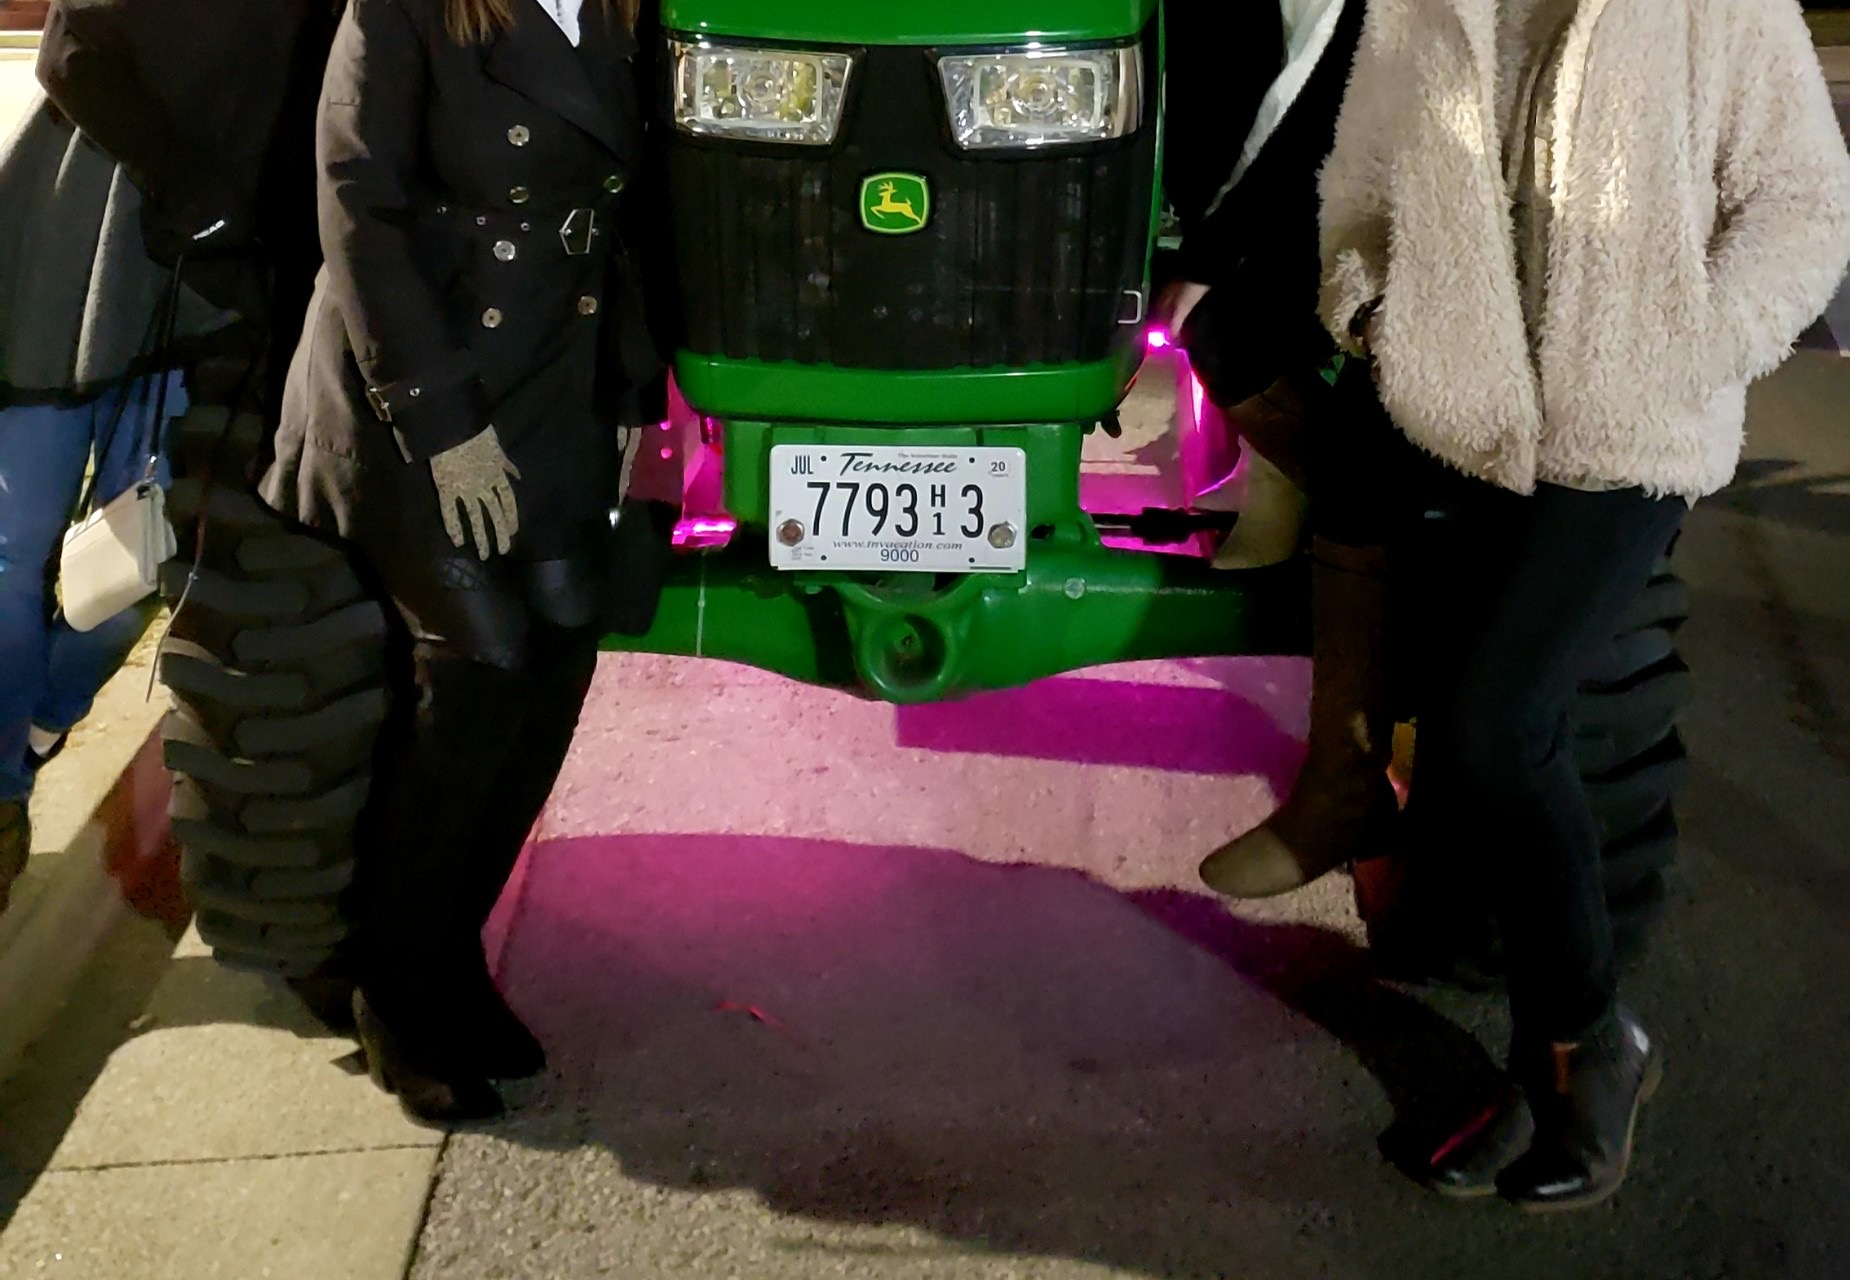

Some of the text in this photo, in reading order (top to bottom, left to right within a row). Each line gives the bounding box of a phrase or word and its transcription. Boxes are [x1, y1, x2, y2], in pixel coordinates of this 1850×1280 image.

[791, 455, 814, 475] JUL
[839, 452, 957, 476] Tennessee
[990, 461, 1006, 472] 20
[806, 481, 919, 537] 7793
[879, 548, 920, 563] 9000
